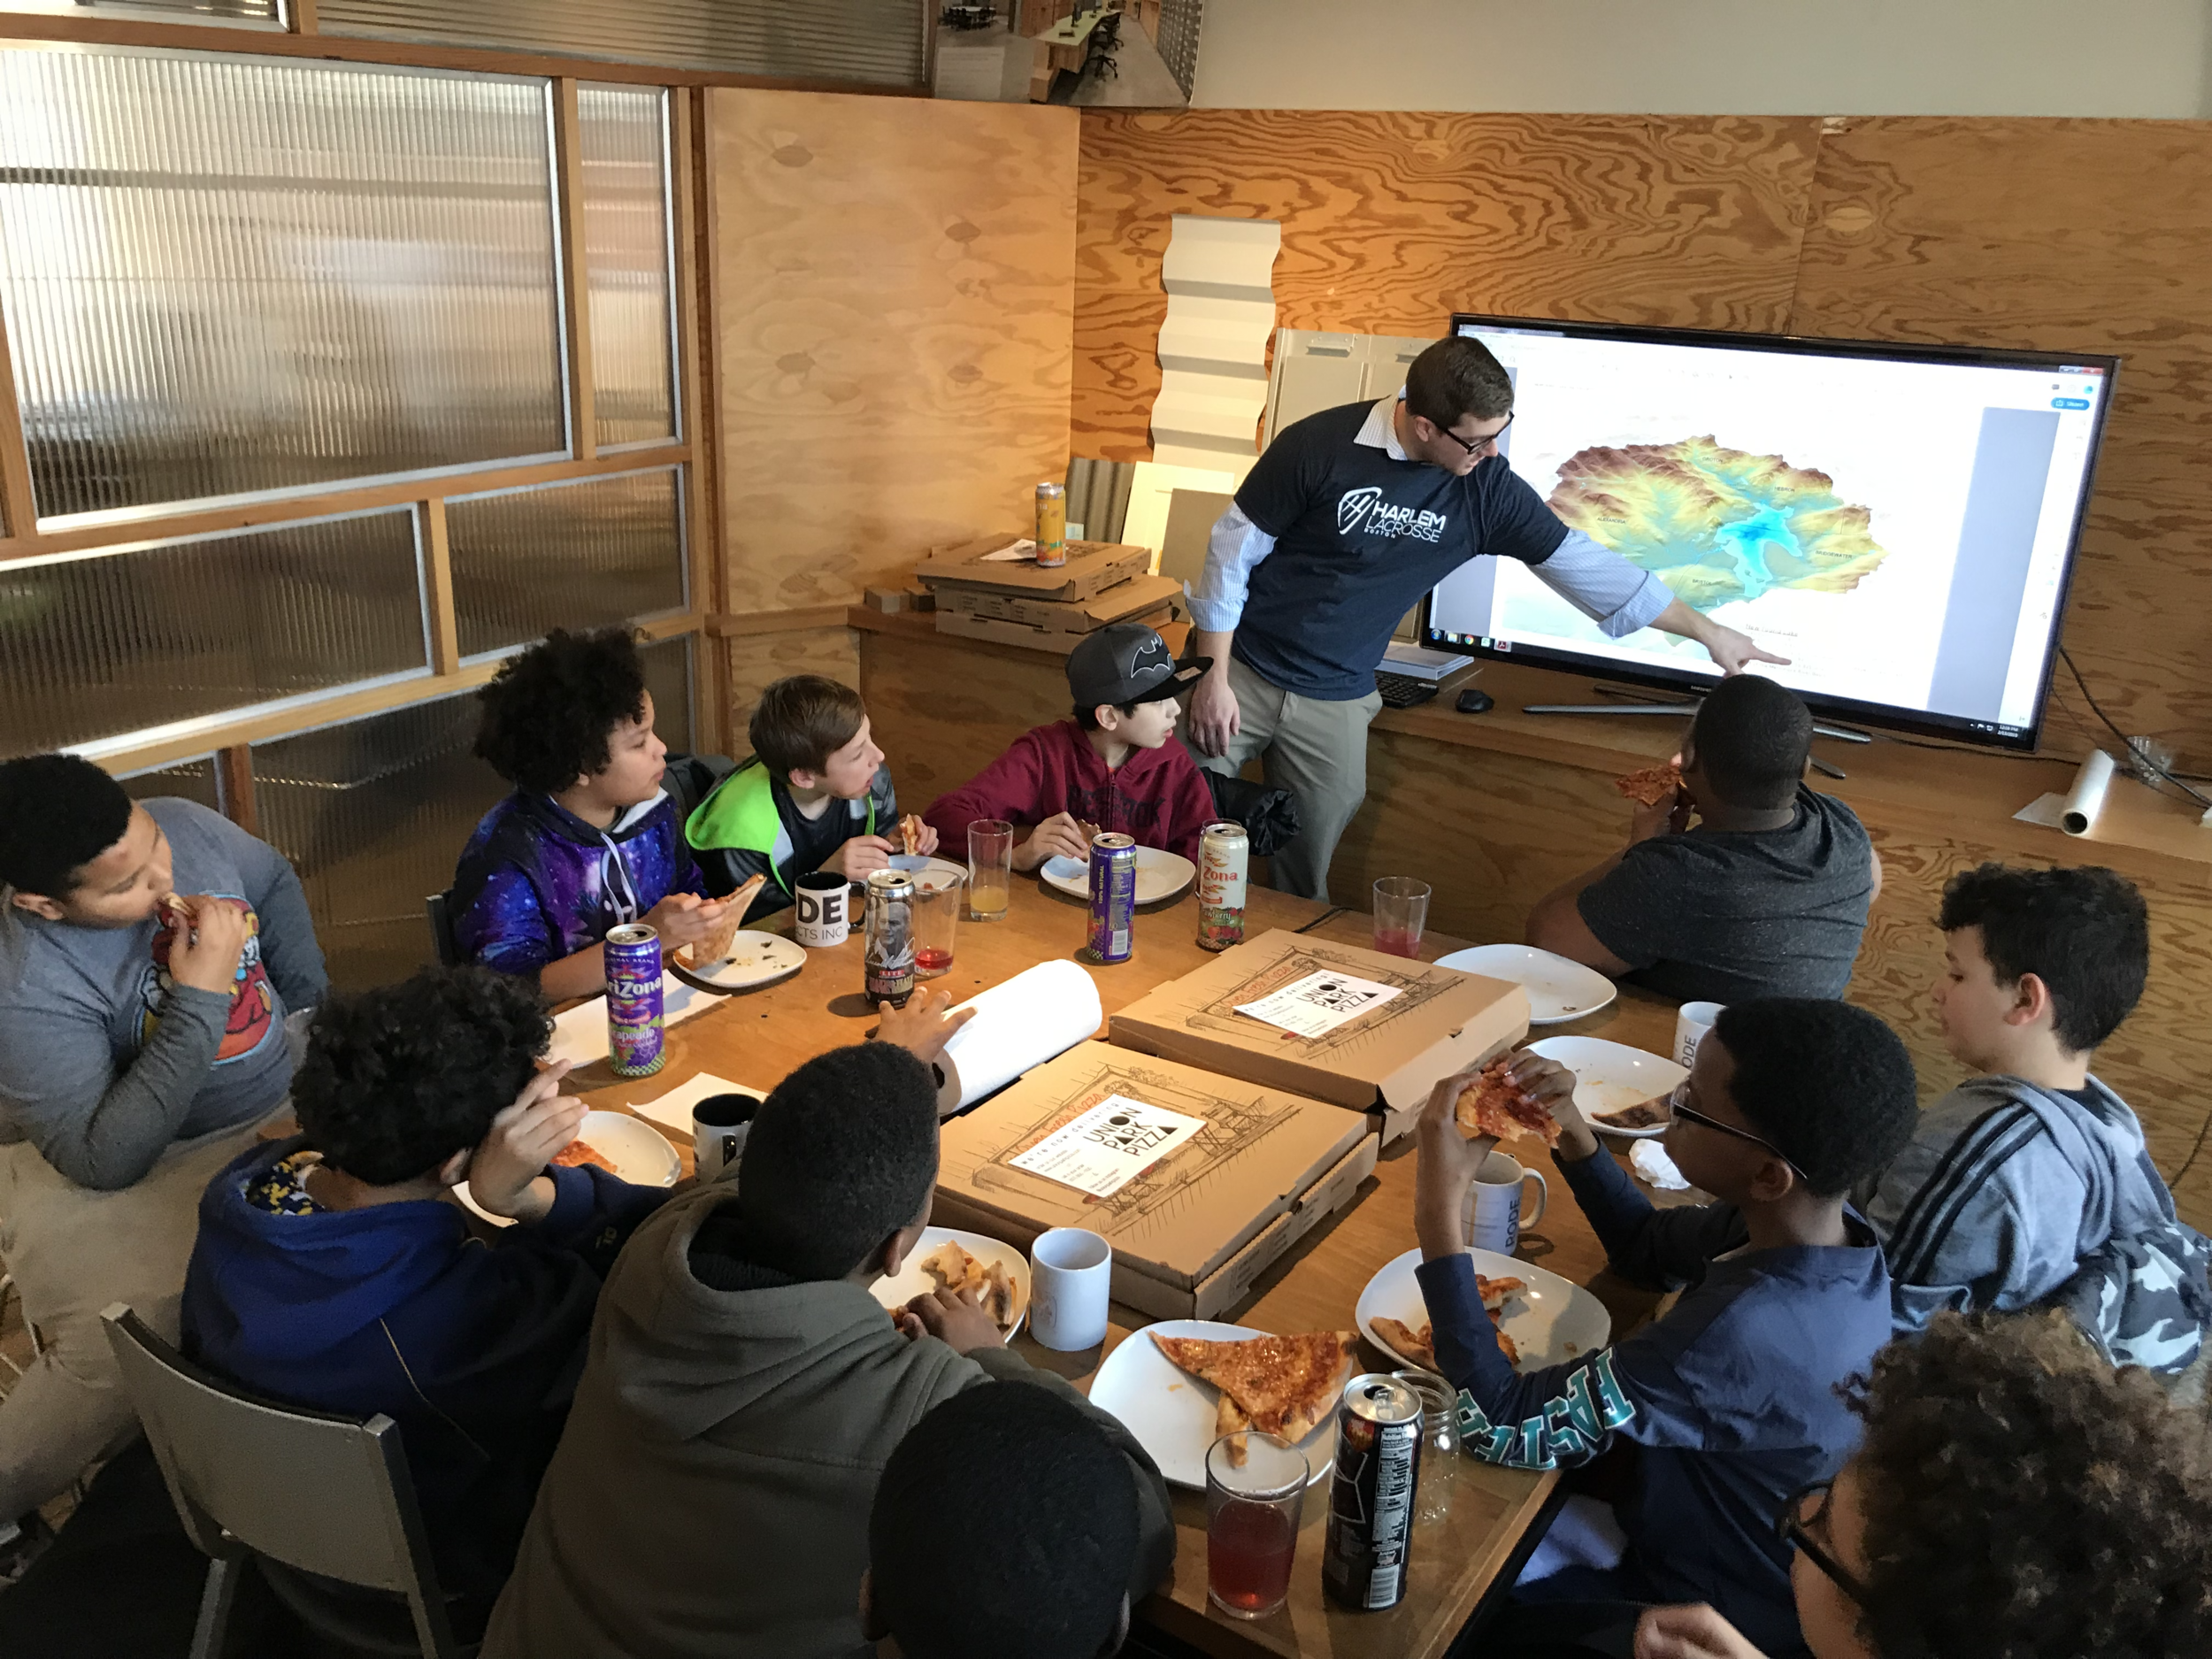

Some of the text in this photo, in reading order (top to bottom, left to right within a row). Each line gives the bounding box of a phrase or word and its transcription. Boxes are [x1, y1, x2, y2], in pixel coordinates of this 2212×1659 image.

[1371, 501, 1447, 530] HARLEM
[1363, 527, 1396, 539] BOSTON
[1365, 516, 1442, 542] LACROSSE
[1815, 549, 1853, 559] BRIDGEWATER
[1203, 866, 1238, 881] Zona
[797, 892, 842, 925] DE
[796, 926, 842, 940] CTS INC
[1296, 978, 1348, 1002] UNION
[1313, 987, 1357, 1008] PARK
[1330, 992, 1379, 1013] PIZZA
[1681, 1035, 1697, 1069] ODE
[1082, 1107, 1143, 1142] UNION
[1102, 1121, 1153, 1150] PARK
[1122, 1125, 1179, 1156] PIZZA
